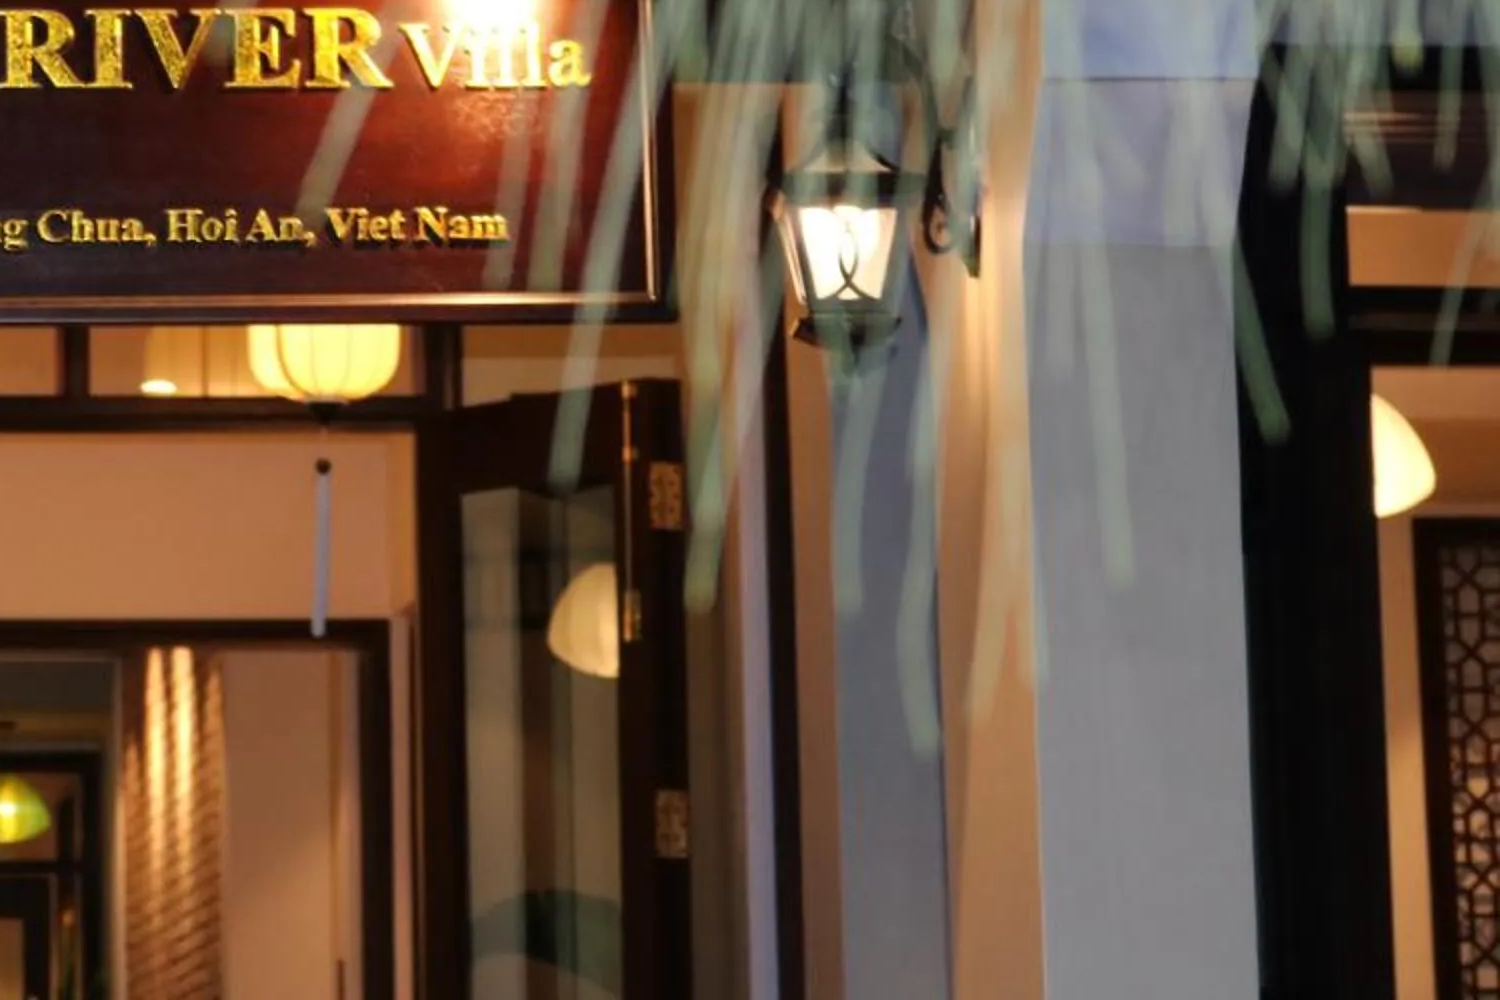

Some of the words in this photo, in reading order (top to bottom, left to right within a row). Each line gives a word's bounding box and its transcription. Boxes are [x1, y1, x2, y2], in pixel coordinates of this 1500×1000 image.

[398, 20, 593, 89] Villa
[37, 208, 157, 246] Chua,
[245, 207, 317, 246] An,
[323, 206, 405, 241] Viet
[411, 205, 509, 242] Nam
